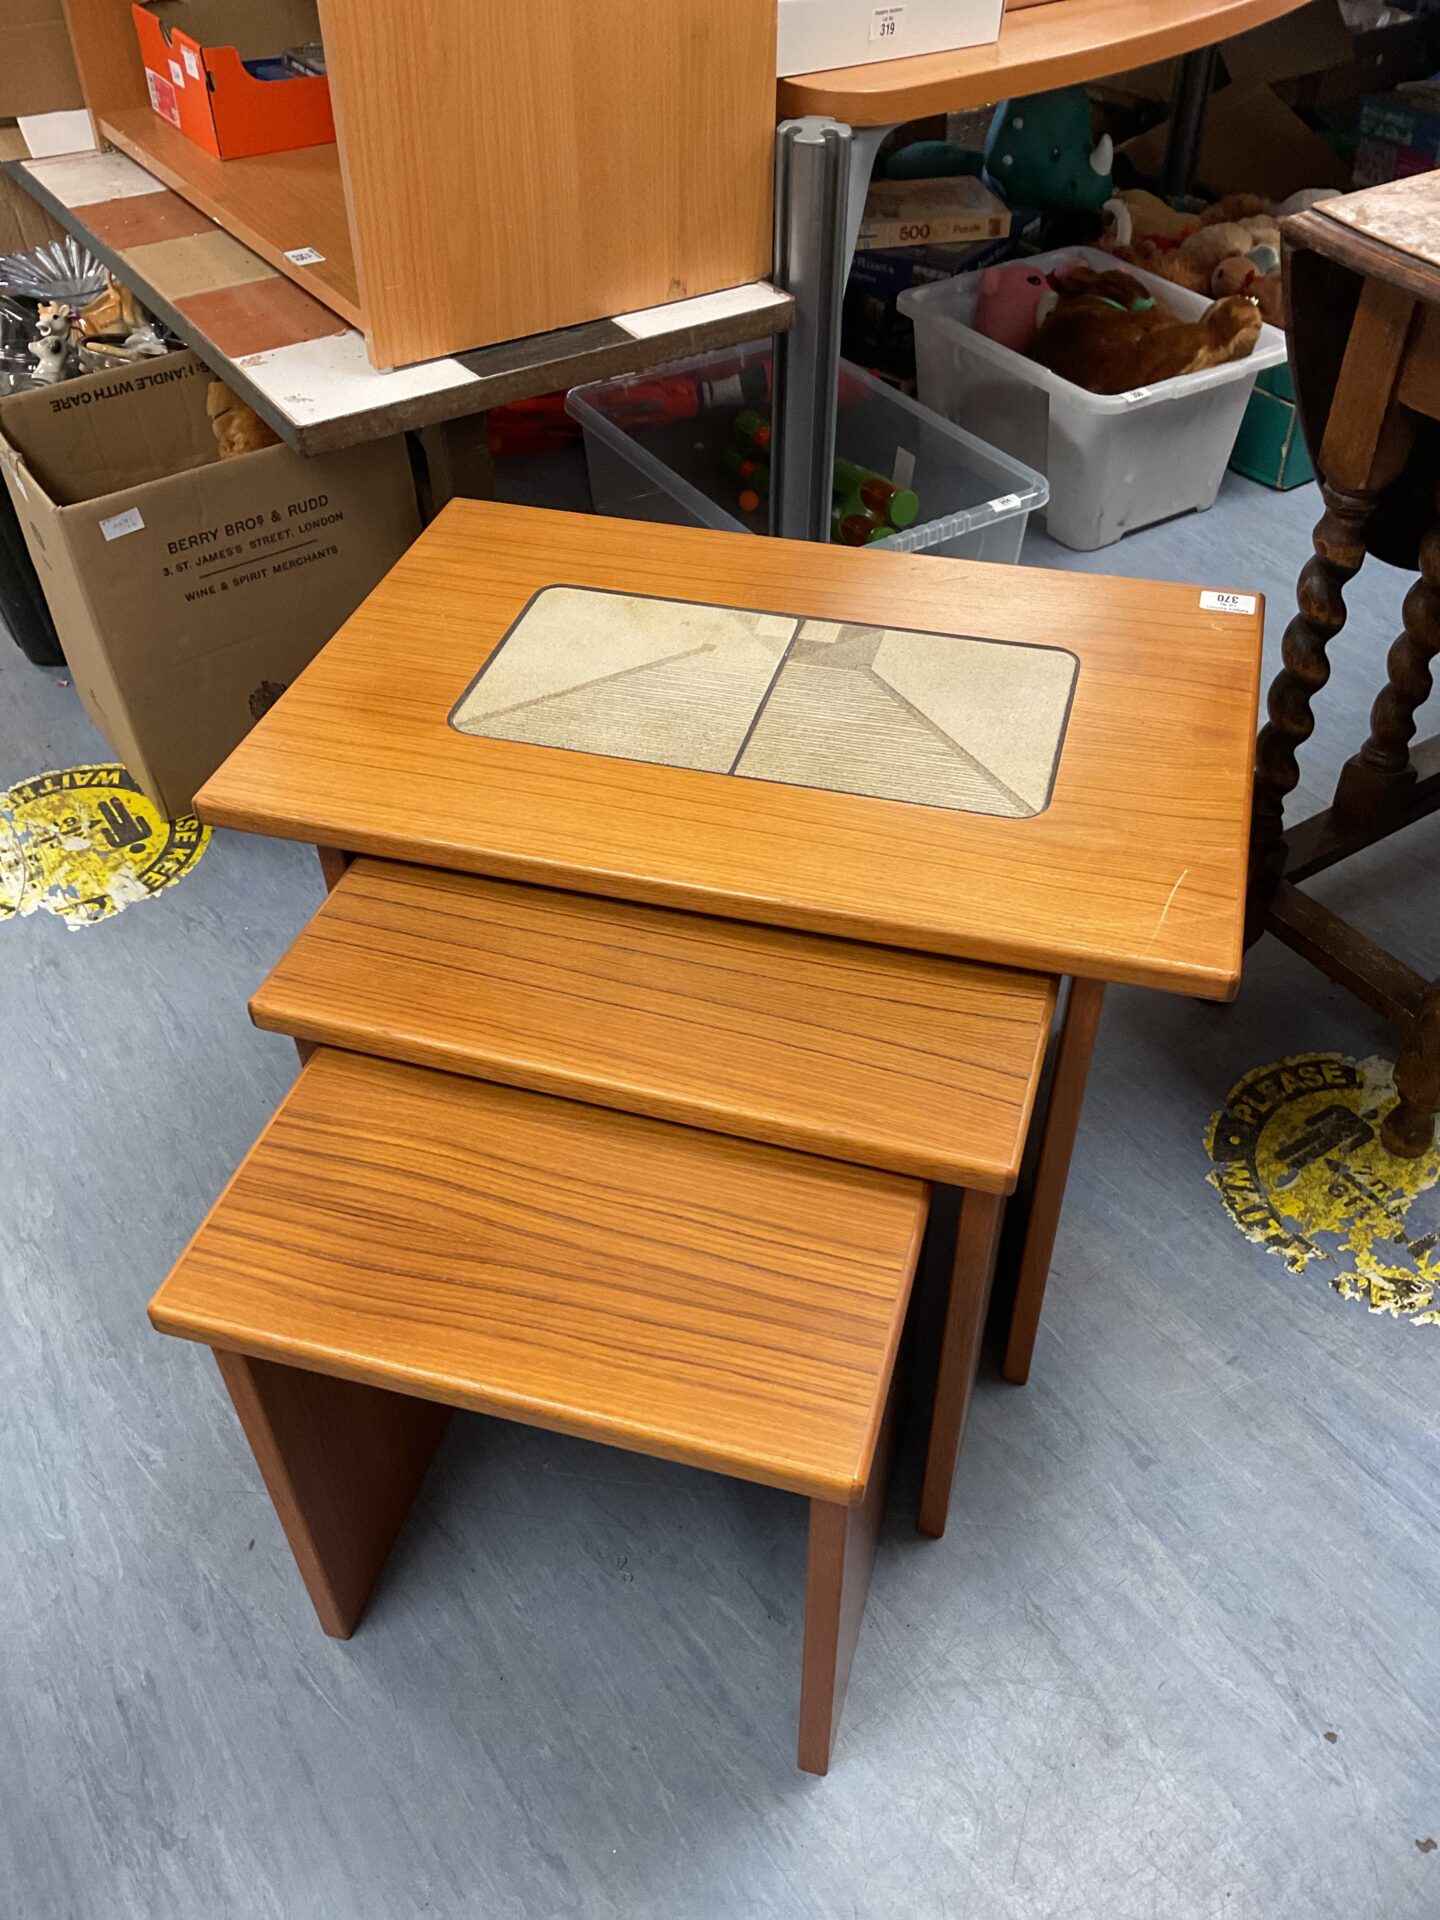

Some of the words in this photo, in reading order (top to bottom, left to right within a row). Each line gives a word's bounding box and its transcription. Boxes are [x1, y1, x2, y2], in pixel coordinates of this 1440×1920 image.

[880, 22, 895, 36] 319
[49, 391, 92, 413] CARE
[93, 383, 134, 400] WITH
[167, 528, 218, 554] BERRY
[271, 510, 282, 523] &
[287, 494, 329, 517] RUDD
[196, 544, 243, 567] JAMES'S
[298, 511, 344, 534] LONDON
[184, 585, 217, 602] WINE
[220, 581, 229, 591] &
[232, 568, 267, 587] SPIRIT
[272, 545, 339, 574] MERCHANTS
[1217, 594, 1239, 604] 370
[39, 769, 121, 794] WAIT
[142, 848, 192, 889] KEE
[1232, 1064, 1348, 1125] PLEASE
